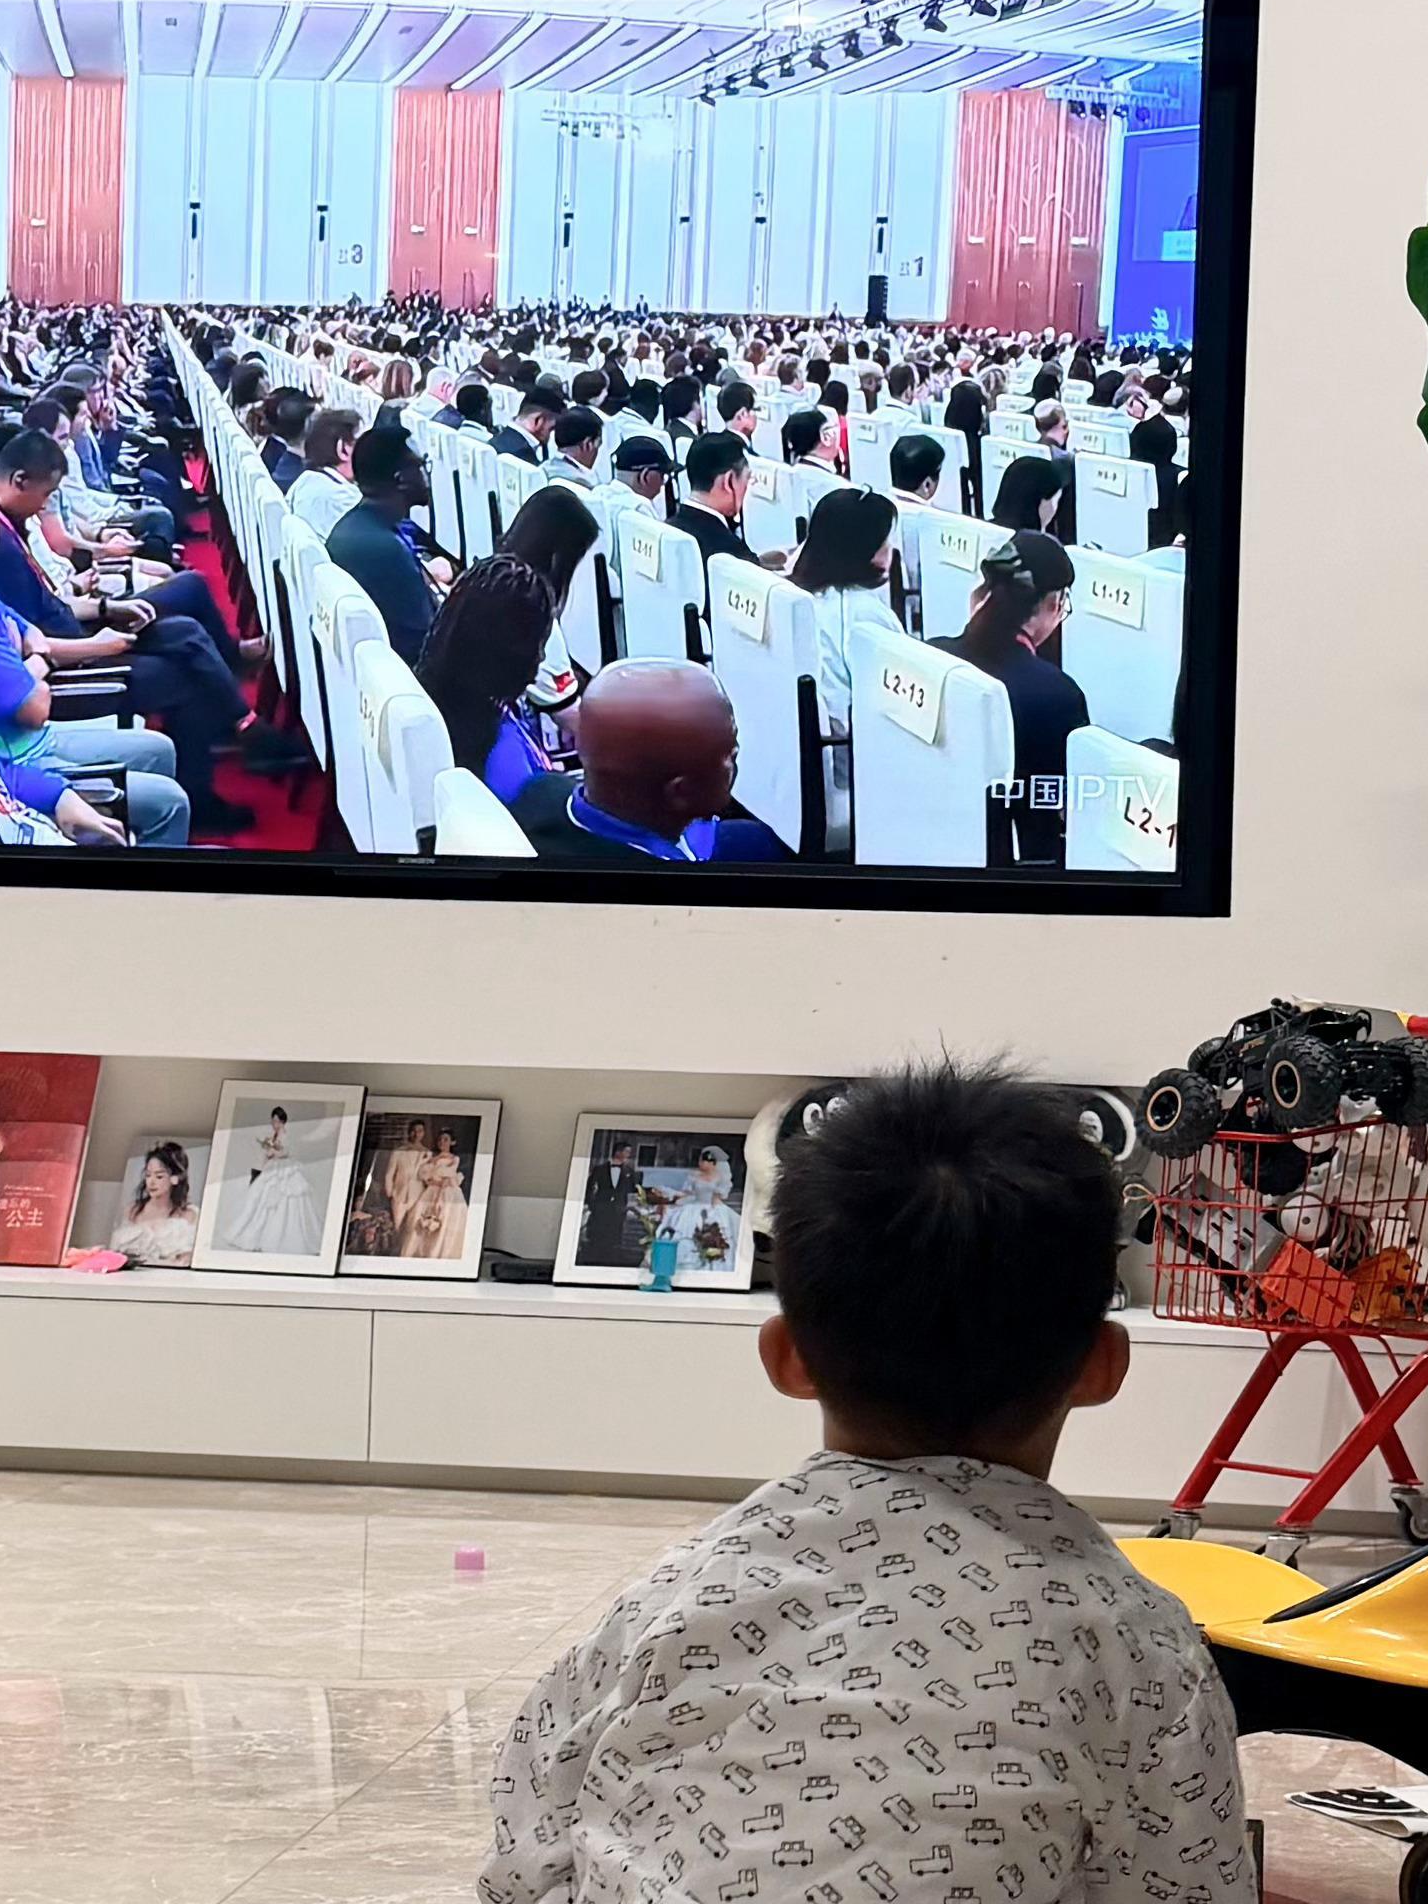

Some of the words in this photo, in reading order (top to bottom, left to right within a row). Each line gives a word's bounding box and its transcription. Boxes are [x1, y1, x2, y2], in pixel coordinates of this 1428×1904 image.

[351, 243, 363, 264] 3
[727, 589, 758, 618] L2-12
[1091, 580, 1131, 607] L1-12
[883, 668, 925, 708] L2-13
